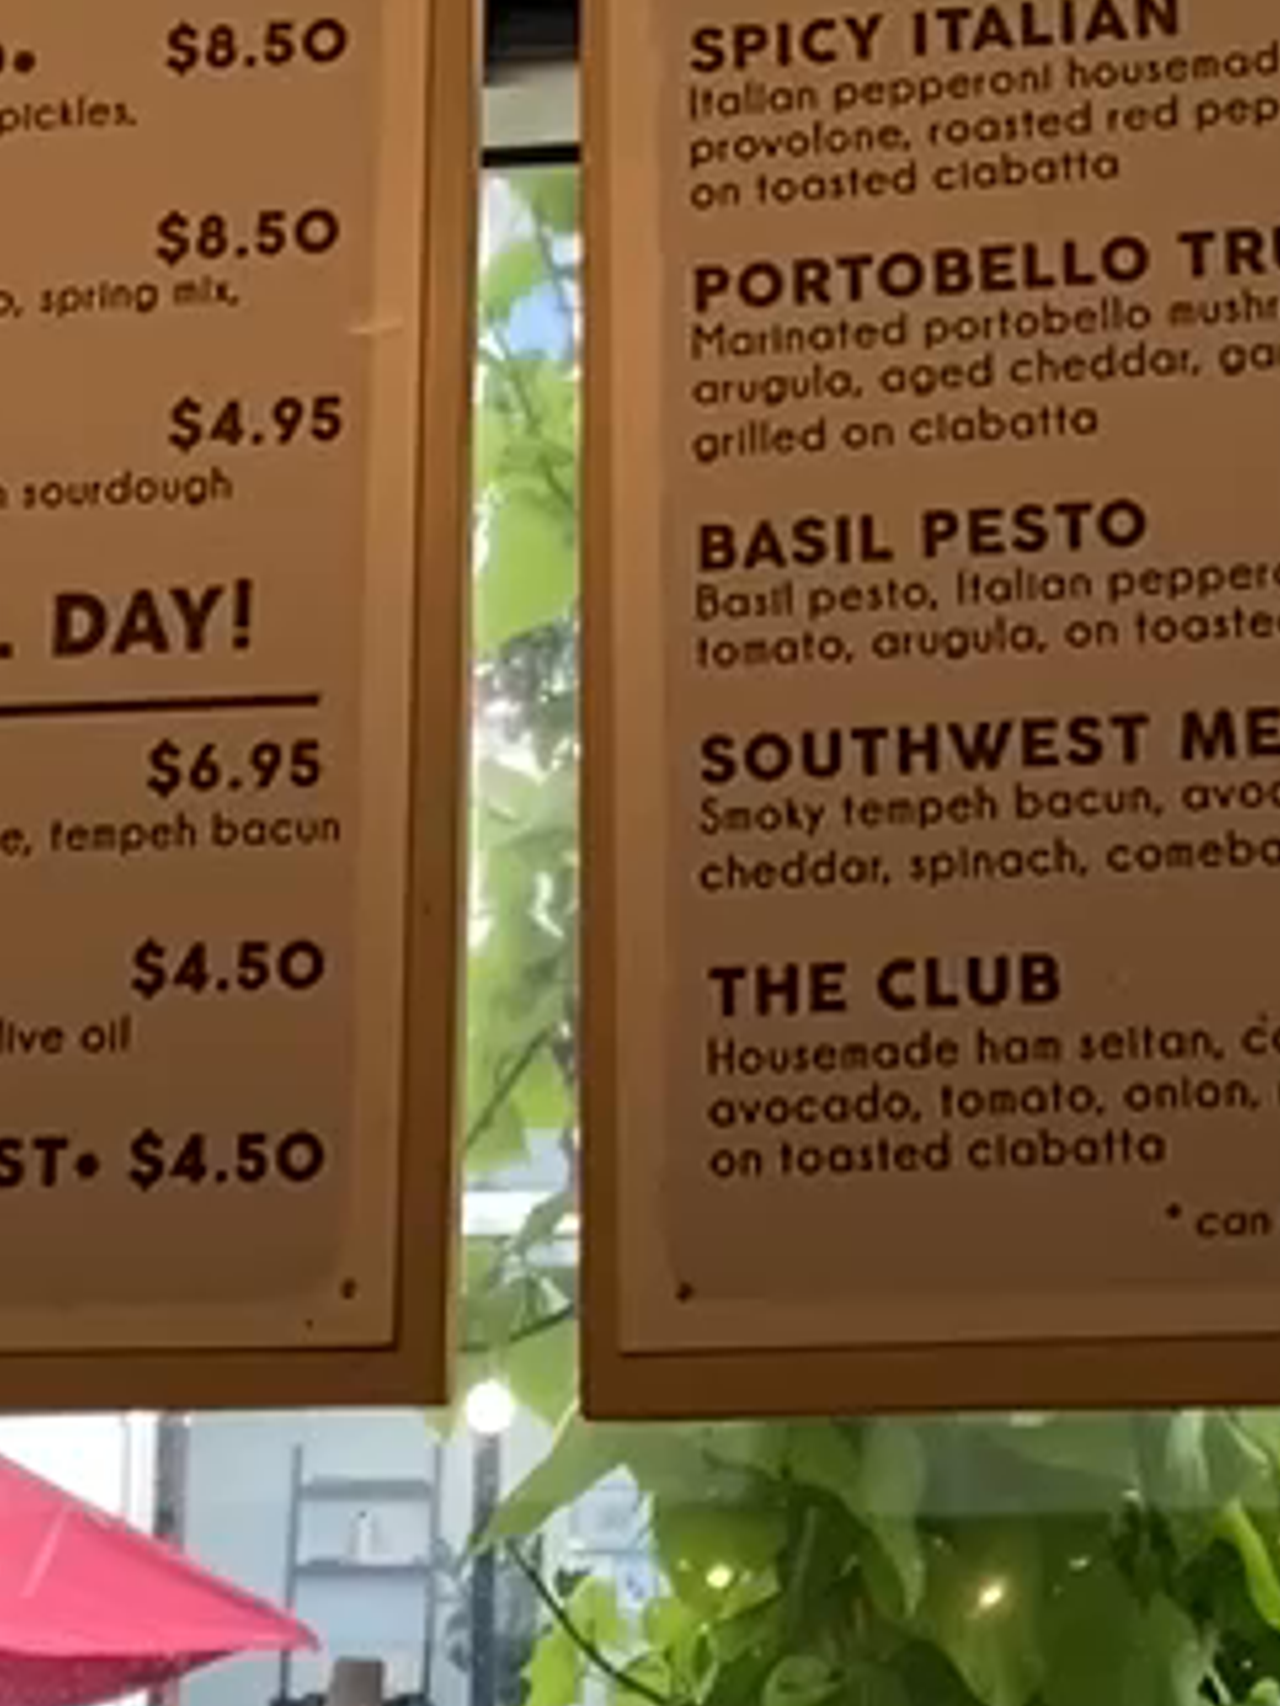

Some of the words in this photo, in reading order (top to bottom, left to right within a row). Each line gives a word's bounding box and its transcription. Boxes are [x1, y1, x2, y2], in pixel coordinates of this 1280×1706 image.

[164, 15, 350, 79] $8.50
[687, 10, 886, 76] SPICY
[686, 75, 821, 124] Italian
[830, 59, 1054, 117] pepperoni
[688, 180, 743, 213] on
[754, 156, 919, 207] toasted
[930, 146, 1121, 194] ciabatta
[153, 206, 342, 270] $8.50
[690, 233, 1153, 318] PORTOBELLO
[689, 308, 912, 363] Marinated
[920, 293, 1154, 354] portobello
[166, 393, 345, 457] $4.95
[690, 412, 829, 466] grilled
[838, 420, 897, 453] on
[906, 401, 1100, 448] ciabatta
[21, 464, 235, 511] sourdough
[695, 511, 897, 576] BASIL
[919, 496, 1149, 562] PESTO
[50, 575, 255, 660] DAY!
[1062, 617, 1121, 650] on
[144, 735, 325, 802] $6.95
[698, 709, 1153, 788] SOUTHWEST
[129, 935, 328, 1002] $4.50
[705, 959, 850, 1020] THE
[874, 950, 1063, 1014] CLUB
[77, 1012, 133, 1056] oil
[704, 1026, 962, 1079] Housemade
[973, 1024, 1065, 1068] ham
[126, 1125, 327, 1195] $4.50
[706, 1146, 766, 1181] on
[775, 1126, 954, 1179] toasted
[965, 1117, 1168, 1173] ciabatta
[1193, 1209, 1275, 1241] can
